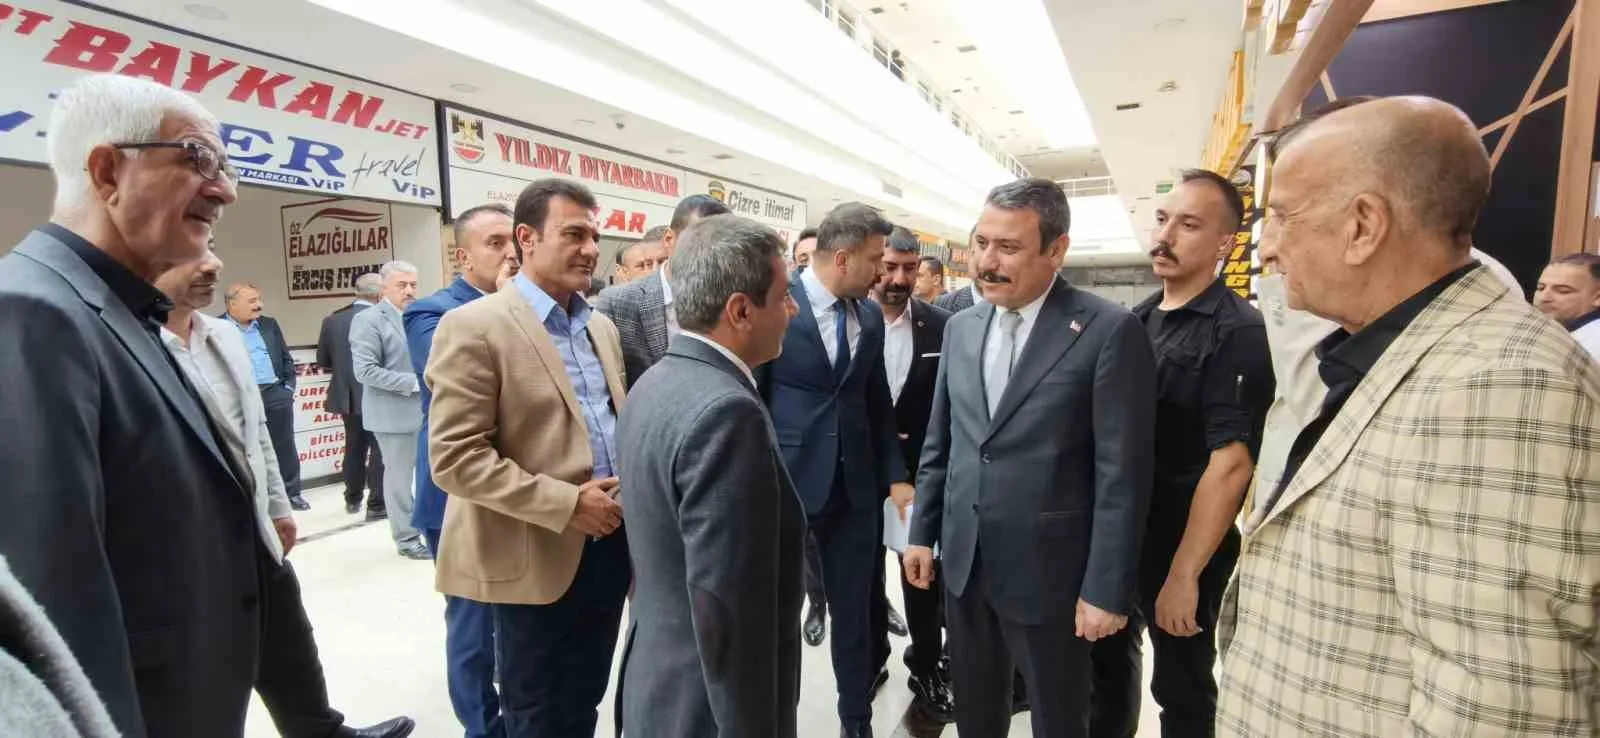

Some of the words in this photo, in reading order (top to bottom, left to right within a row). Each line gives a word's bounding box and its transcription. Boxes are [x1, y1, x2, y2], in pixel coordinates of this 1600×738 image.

[43, 19, 384, 129] BAYKAN
[375, 118, 430, 141] JET
[217, 122, 346, 178] ER
[352, 147, 426, 190] travel
[494, 132, 573, 175] YILDIZ
[247, 169, 298, 185] MARKASI
[288, 225, 389, 258] ELAZIĞLILAR
[310, 432, 344, 446] BİTLİS
